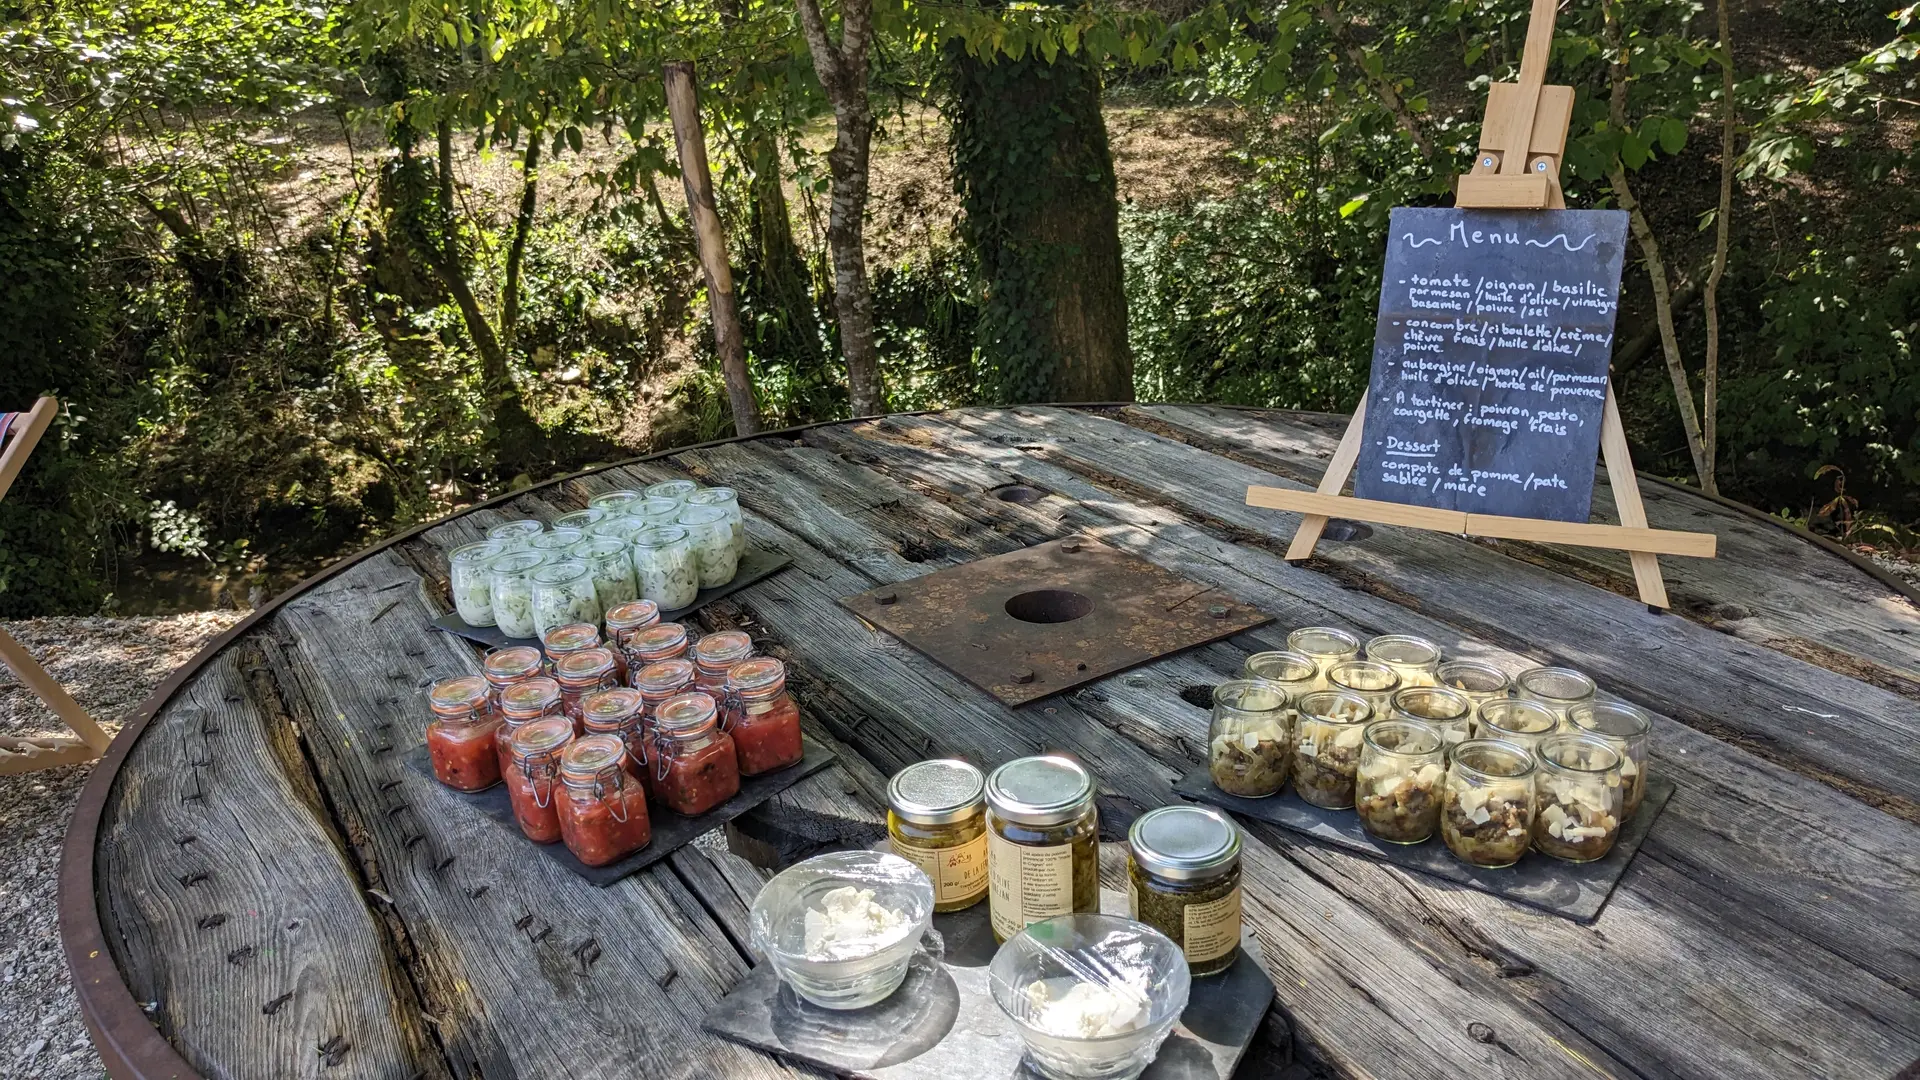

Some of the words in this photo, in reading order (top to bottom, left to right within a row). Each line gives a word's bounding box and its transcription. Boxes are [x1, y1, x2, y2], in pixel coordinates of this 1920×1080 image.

[1450, 220, 1520, 248] Menu
[1408, 287, 1470, 300] parmesan
[1410, 273, 1471, 287] tomate
[1552, 280, 1608, 298] basilic
[1403, 328, 1444, 342] chèvre
[1401, 370, 1429, 382] huile
[1494, 378, 1526, 391] herbe
[1530, 381, 1545, 392] de
[1550, 387, 1605, 402] provence
[1410, 393, 1464, 410] tartiner
[1463, 412, 1518, 435] fromage
[1530, 418, 1567, 436] frais
[1386, 436, 1441, 453] Dessert
[1382, 461, 1440, 477] compote
[1448, 462, 1464, 476] de
[1470, 470, 1522, 484] pomme
